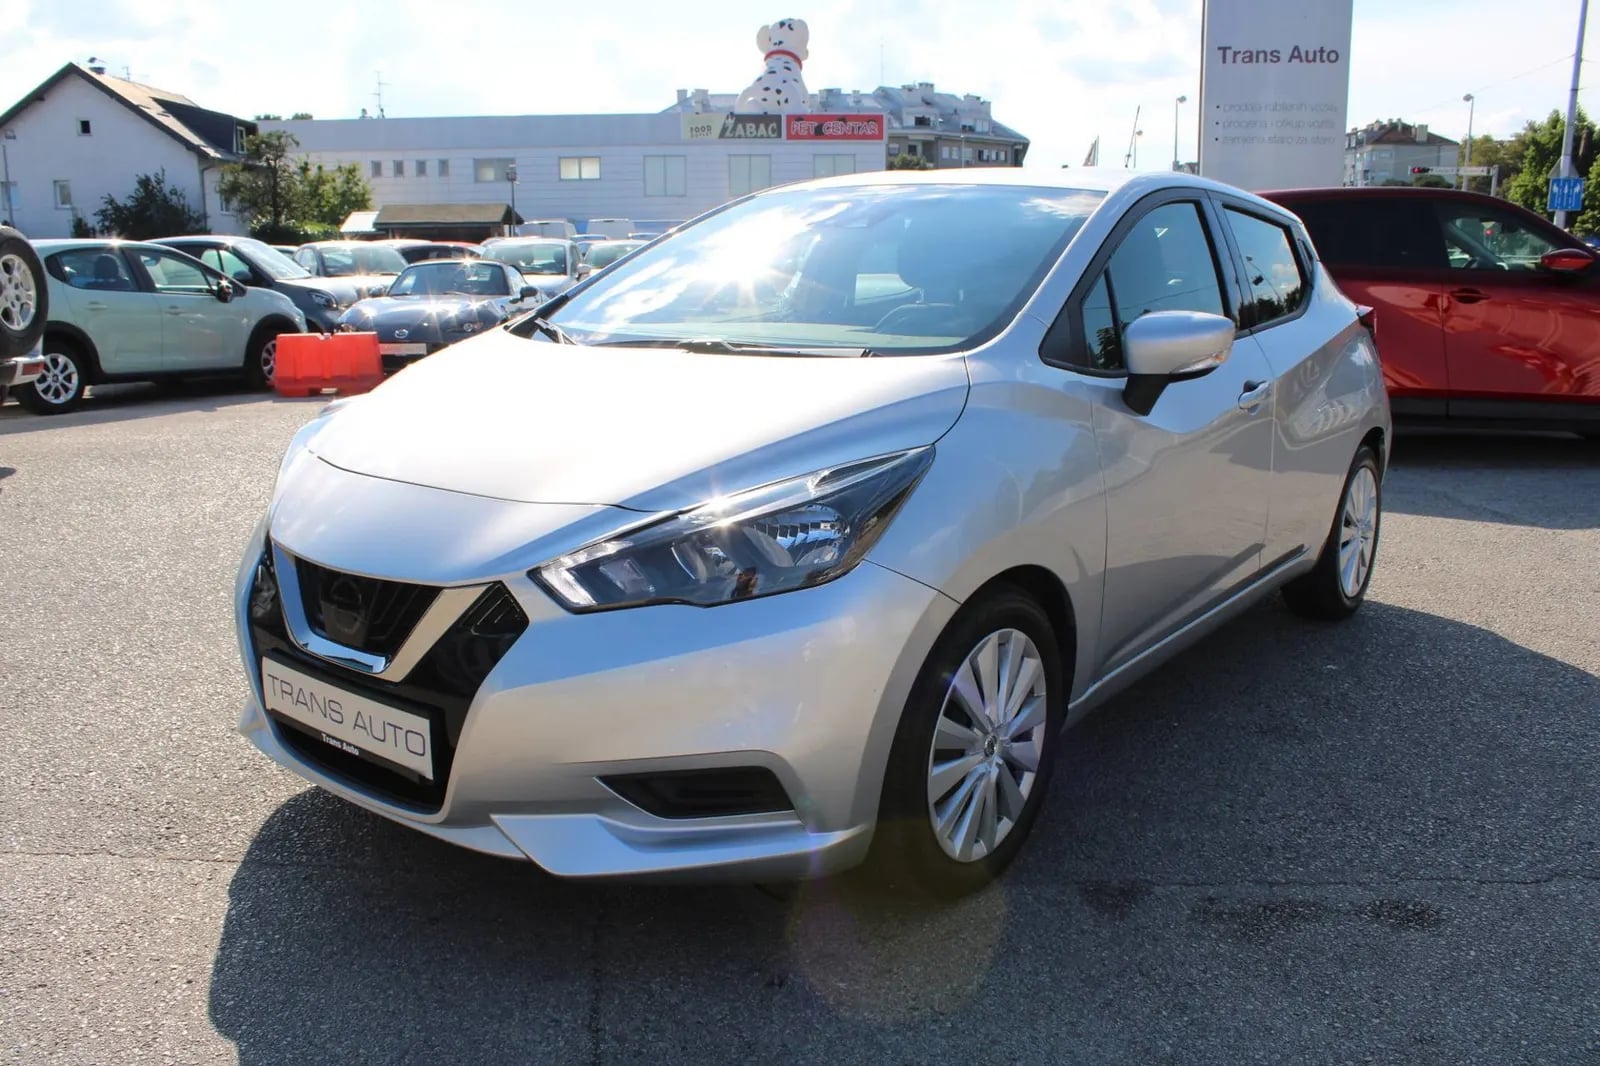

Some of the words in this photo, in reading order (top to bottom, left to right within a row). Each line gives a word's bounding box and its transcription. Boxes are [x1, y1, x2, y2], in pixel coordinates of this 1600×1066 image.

[1217, 46, 1281, 64] Trans
[1287, 45, 1340, 64] Auto
[791, 121, 818, 135] PET
[822, 120, 879, 135] CENTAR
[267, 673, 344, 725] TRANS
[353, 711, 426, 757] AUTO
[321, 732, 342, 749] Trans
